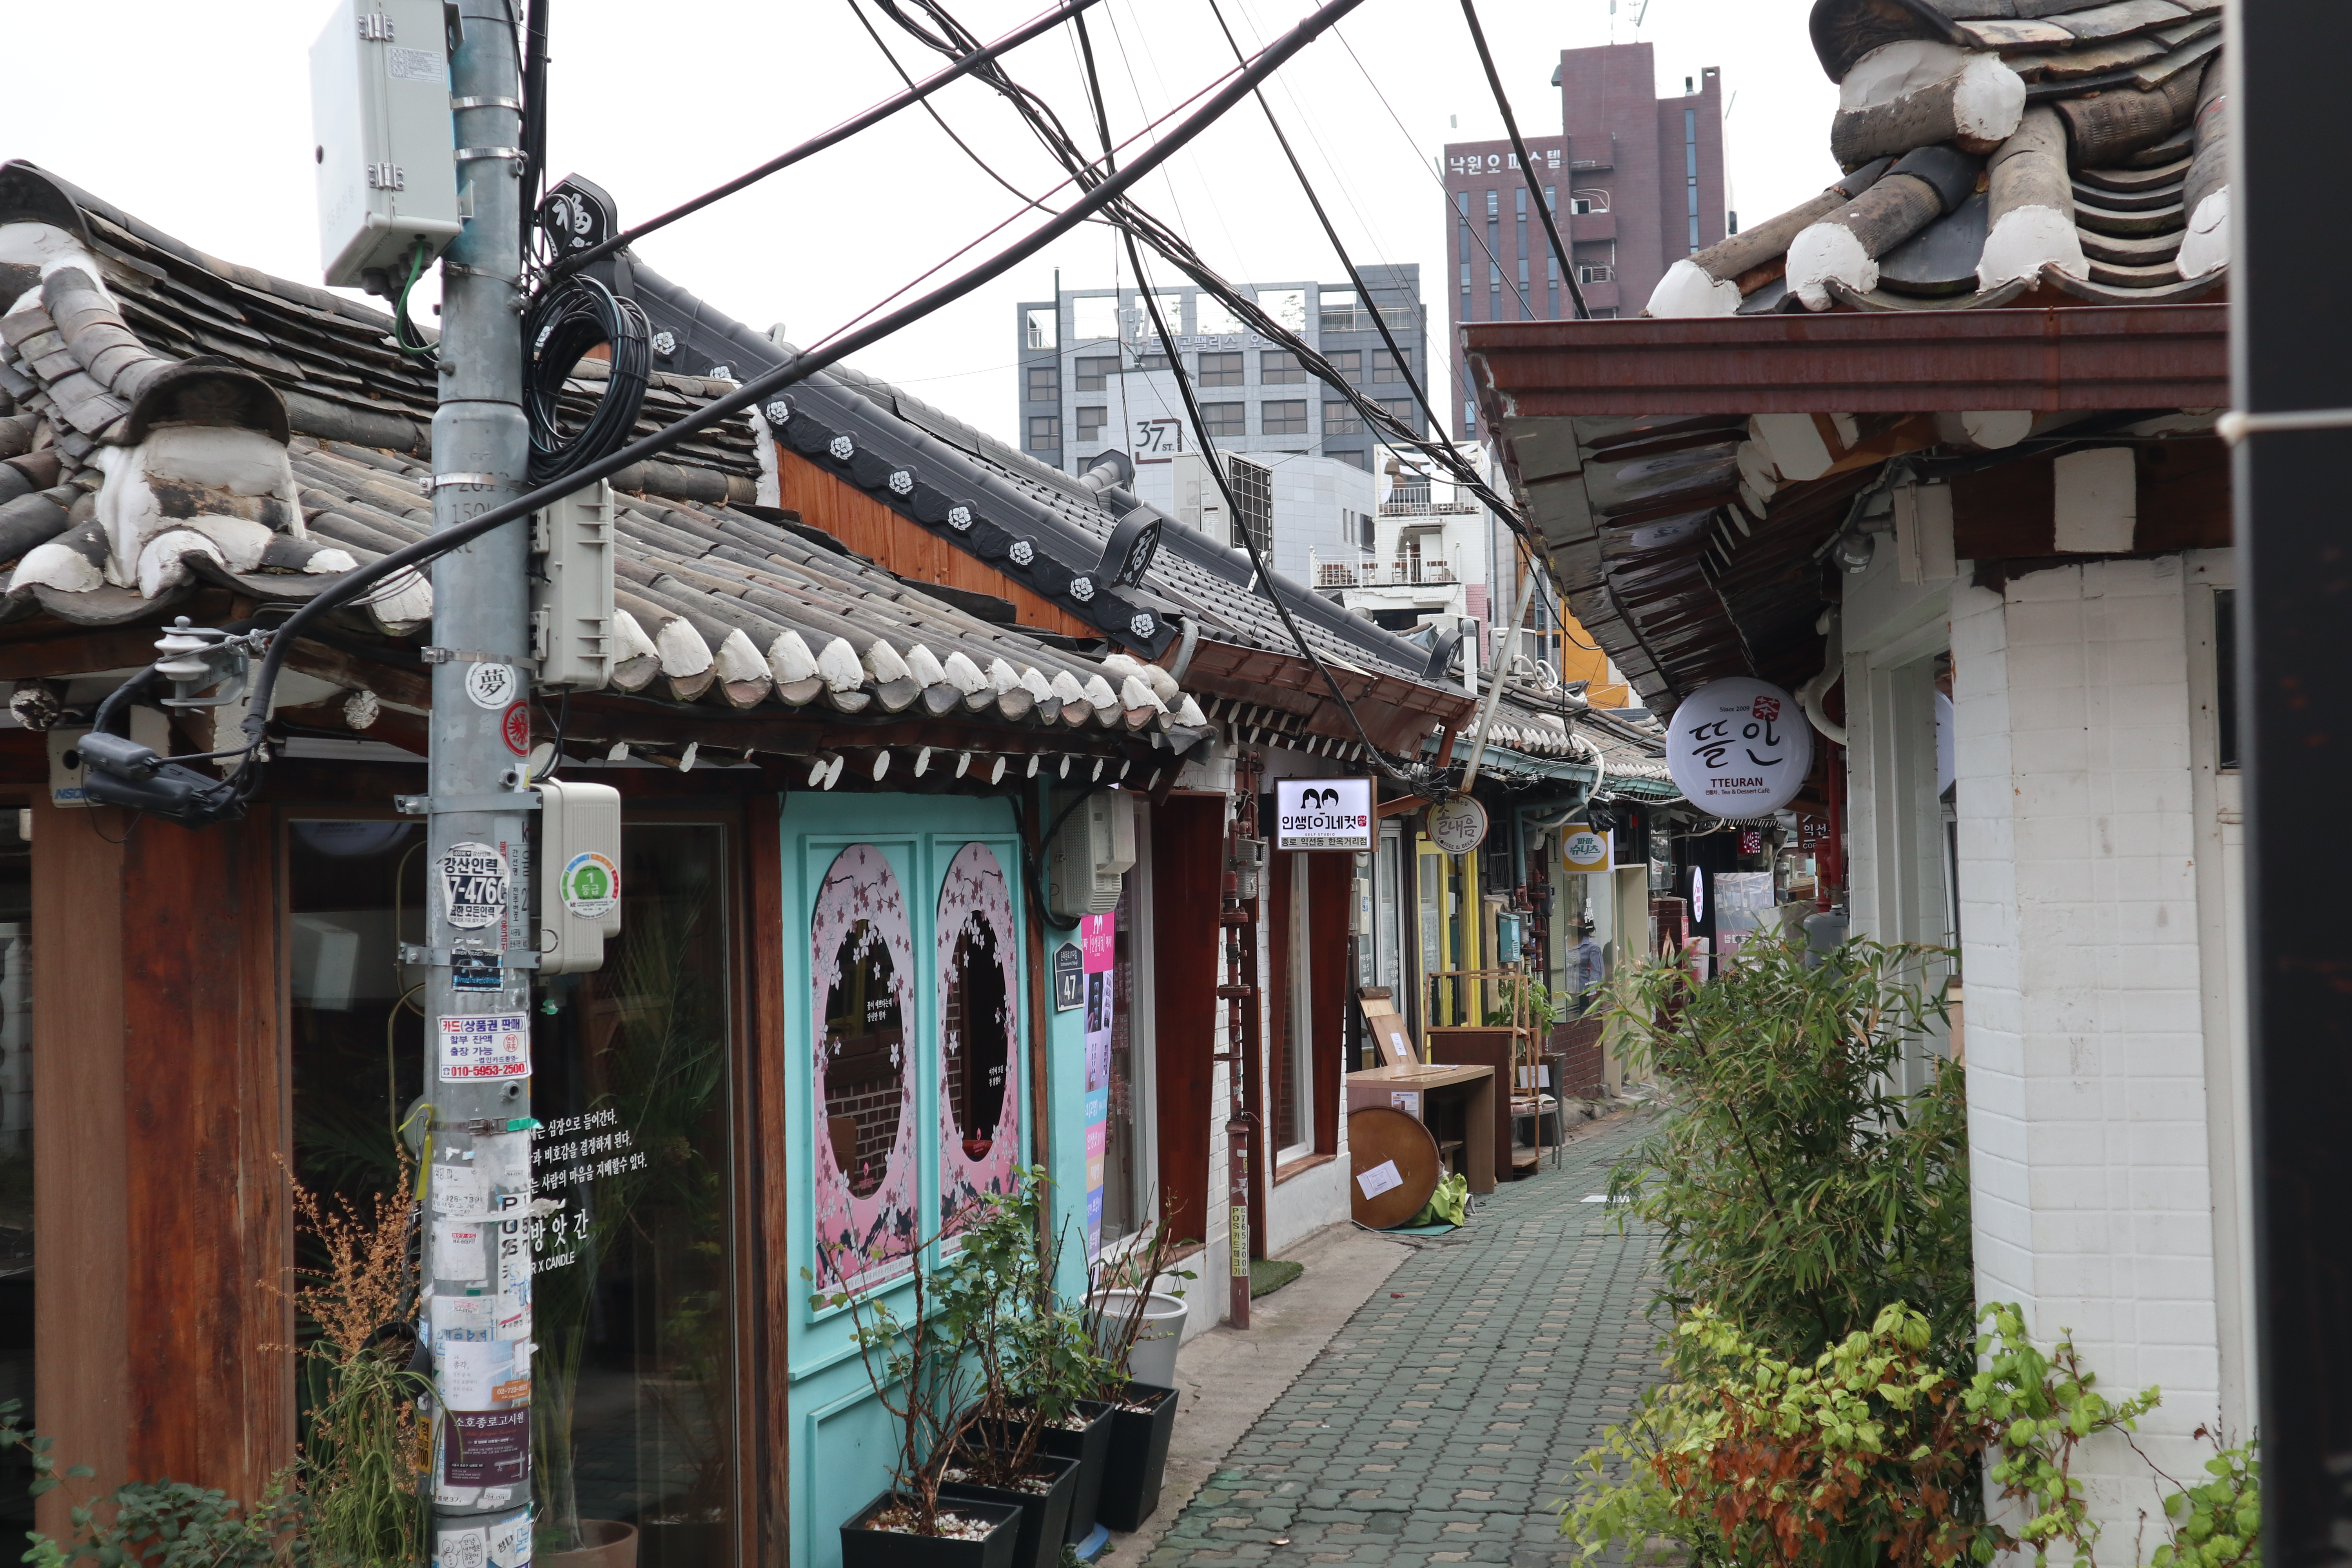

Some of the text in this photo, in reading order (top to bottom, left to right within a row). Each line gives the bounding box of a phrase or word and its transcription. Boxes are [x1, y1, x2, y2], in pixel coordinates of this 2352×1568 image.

[1150, 334, 1237, 352] 드곤팰리스
[1135, 421, 1164, 452] 37
[477, 669, 506, 698] 夢
[1689, 715, 1783, 768] 뜰안
[1710, 777, 1763, 788] TTEURAN
[1804, 823, 1831, 836] 익선
[1282, 837, 1367, 846] 종로 익선동 한옥거리점
[1462, 839, 1474, 848] BEER
[1570, 844, 1601, 855] 슈니츠
[444, 857, 497, 875] 강산인력
[586, 872, 593, 883] 1
[581, 884, 599, 895] 등급
[465, 906, 494, 917] 모든인력
[1064, 975, 1076, 1000] 47
[443, 1020, 497, 1033] 카드(상품권
[450, 1035, 492, 1045] 할부 잔액
[450, 1047, 493, 1056] 출장 가능
[451, 1063, 525, 1076] 010-5953-2500
[548, 1117, 581, 1138] 심장으로
[583, 1108, 618, 1130] 들어간다.
[544, 1142, 578, 1164] 비호감을
[580, 1134, 612, 1156] 결정하게
[614, 1130, 632, 1149] 된다.
[541, 1170, 566, 1191] 사람의
[569, 1164, 594, 1185] 마음을
[597, 1157, 628, 1178] 지배할수
[630, 1152, 647, 1171] 있다.
[538, 1259, 544, 1273] X
[546, 1251, 575, 1271] CANDLE
[453, 1361, 469, 1369] 종각,
[497, 1384, 528, 1395] 02-722-0551
[454, 1412, 524, 1428] 소호종로고시원
